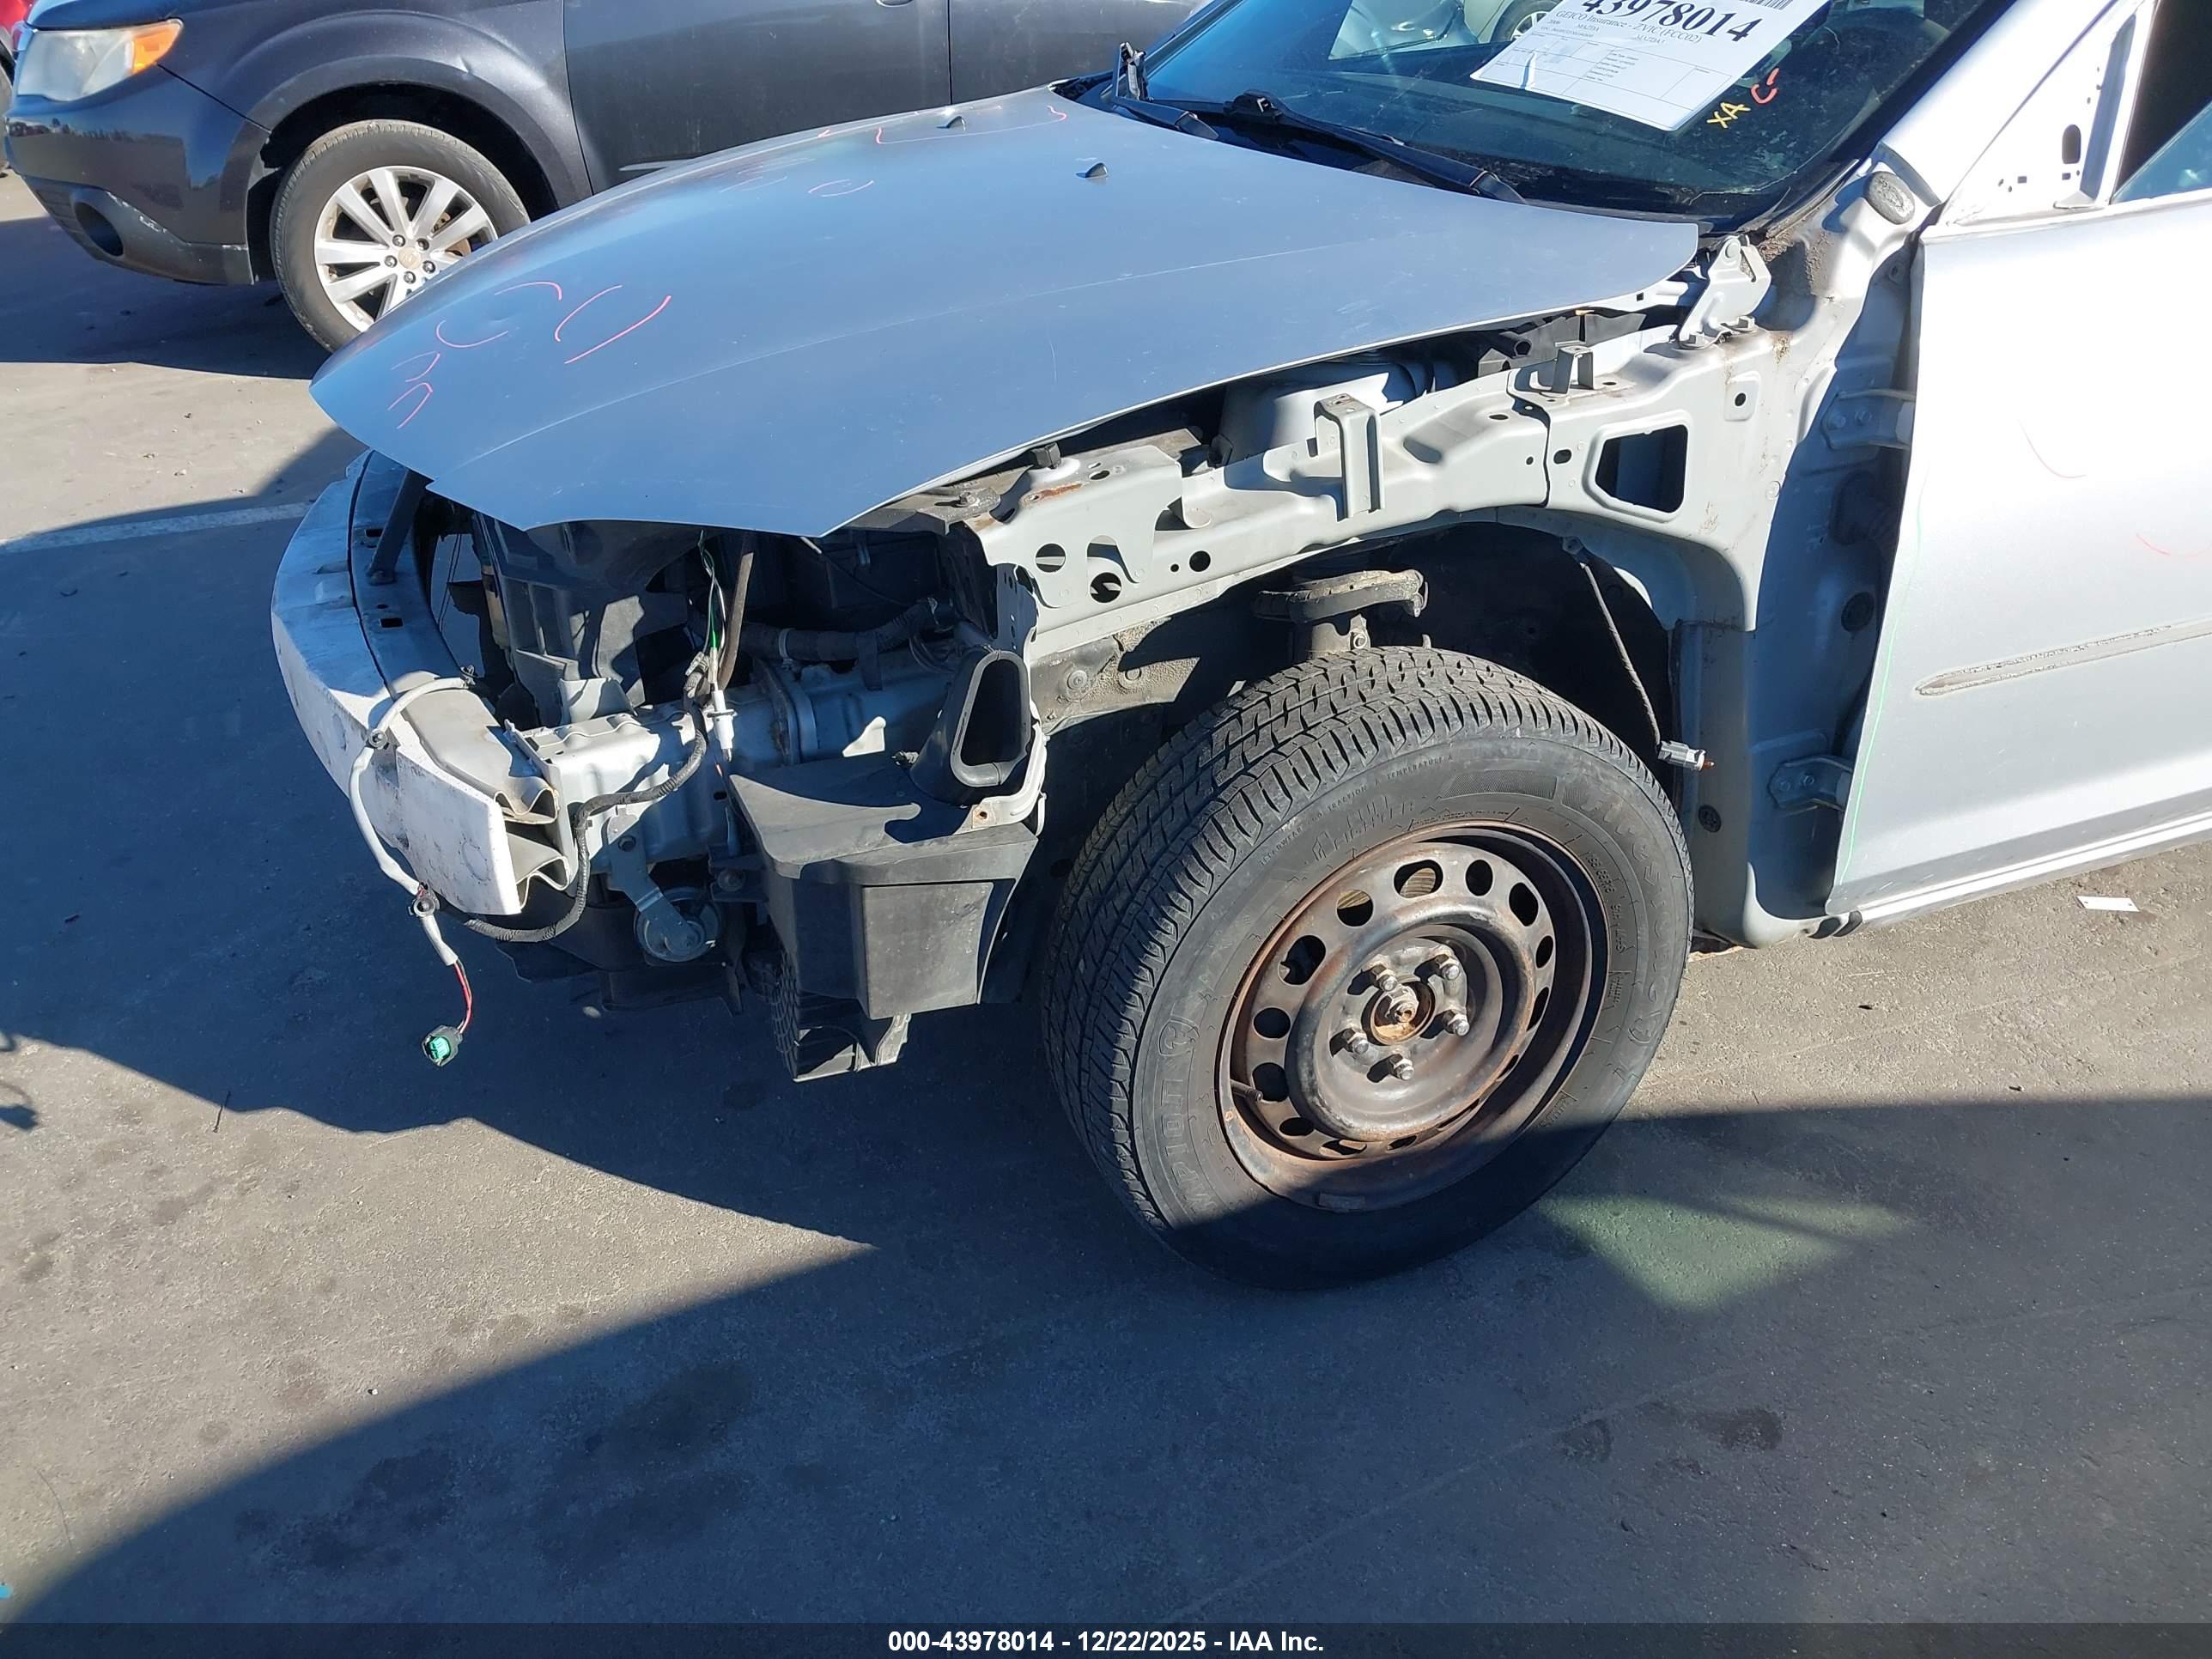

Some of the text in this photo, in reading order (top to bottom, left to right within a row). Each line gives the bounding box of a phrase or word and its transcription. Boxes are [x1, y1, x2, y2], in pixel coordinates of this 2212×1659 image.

[1556, 10, 1587, 21] GEICO
[1588, 15, 1628, 27] Insurance
[1632, 22, 1662, 34] ZVIC
[1660, 29, 1703, 44] (FCC02)
[1328, 784, 1367, 811] TRACTION
[1387, 758, 1443, 780] TEMPERATURE
